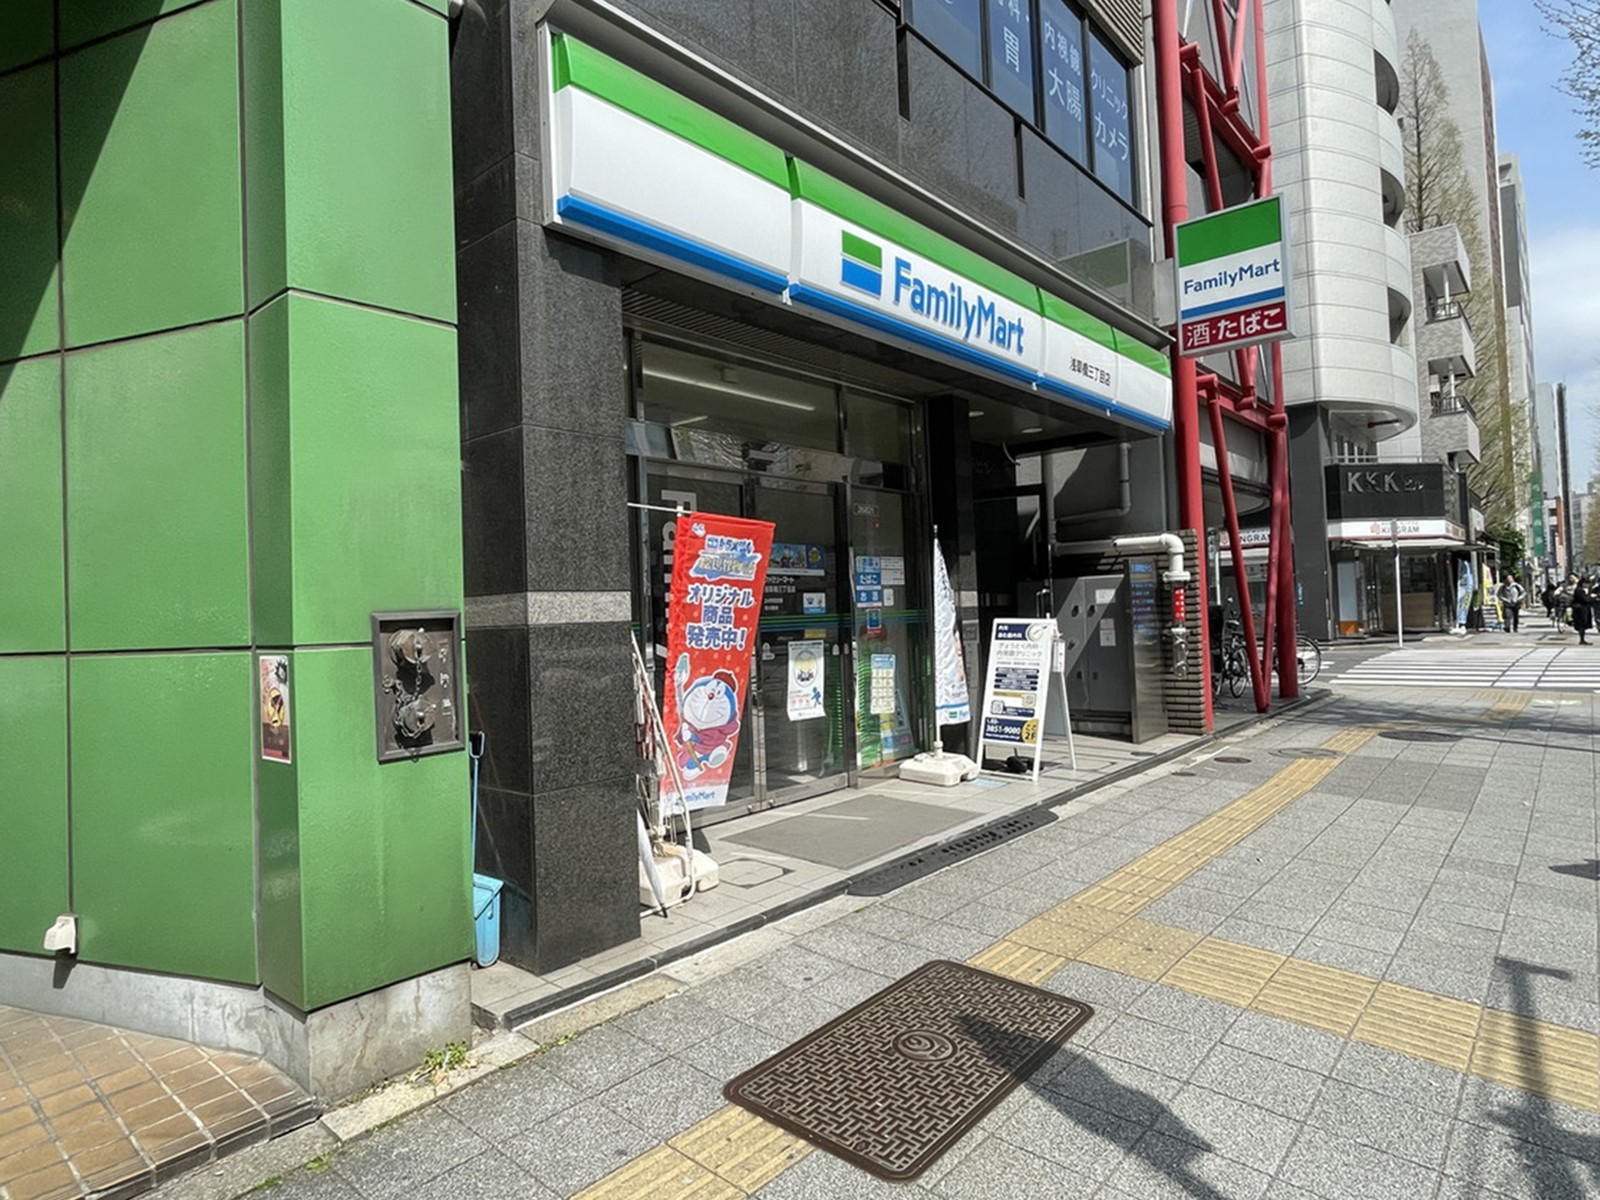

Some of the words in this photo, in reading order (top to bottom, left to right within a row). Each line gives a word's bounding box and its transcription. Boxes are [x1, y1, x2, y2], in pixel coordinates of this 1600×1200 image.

[1003, 26, 1020, 73] 胃
[1094, 113, 1129, 161] カメラ
[1091, 68, 1128, 120] クリニック
[1183, 259, 1280, 295] FamilyMart
[894, 256, 1024, 356] FamilyMart
[1186, 308, 1283, 347] 酒・たばこ
[1381, 526, 1419, 534] KIGRAM
[688, 584, 754, 607] オリジナル
[703, 605, 733, 624] 商品
[687, 625, 746, 650] 発売中!
